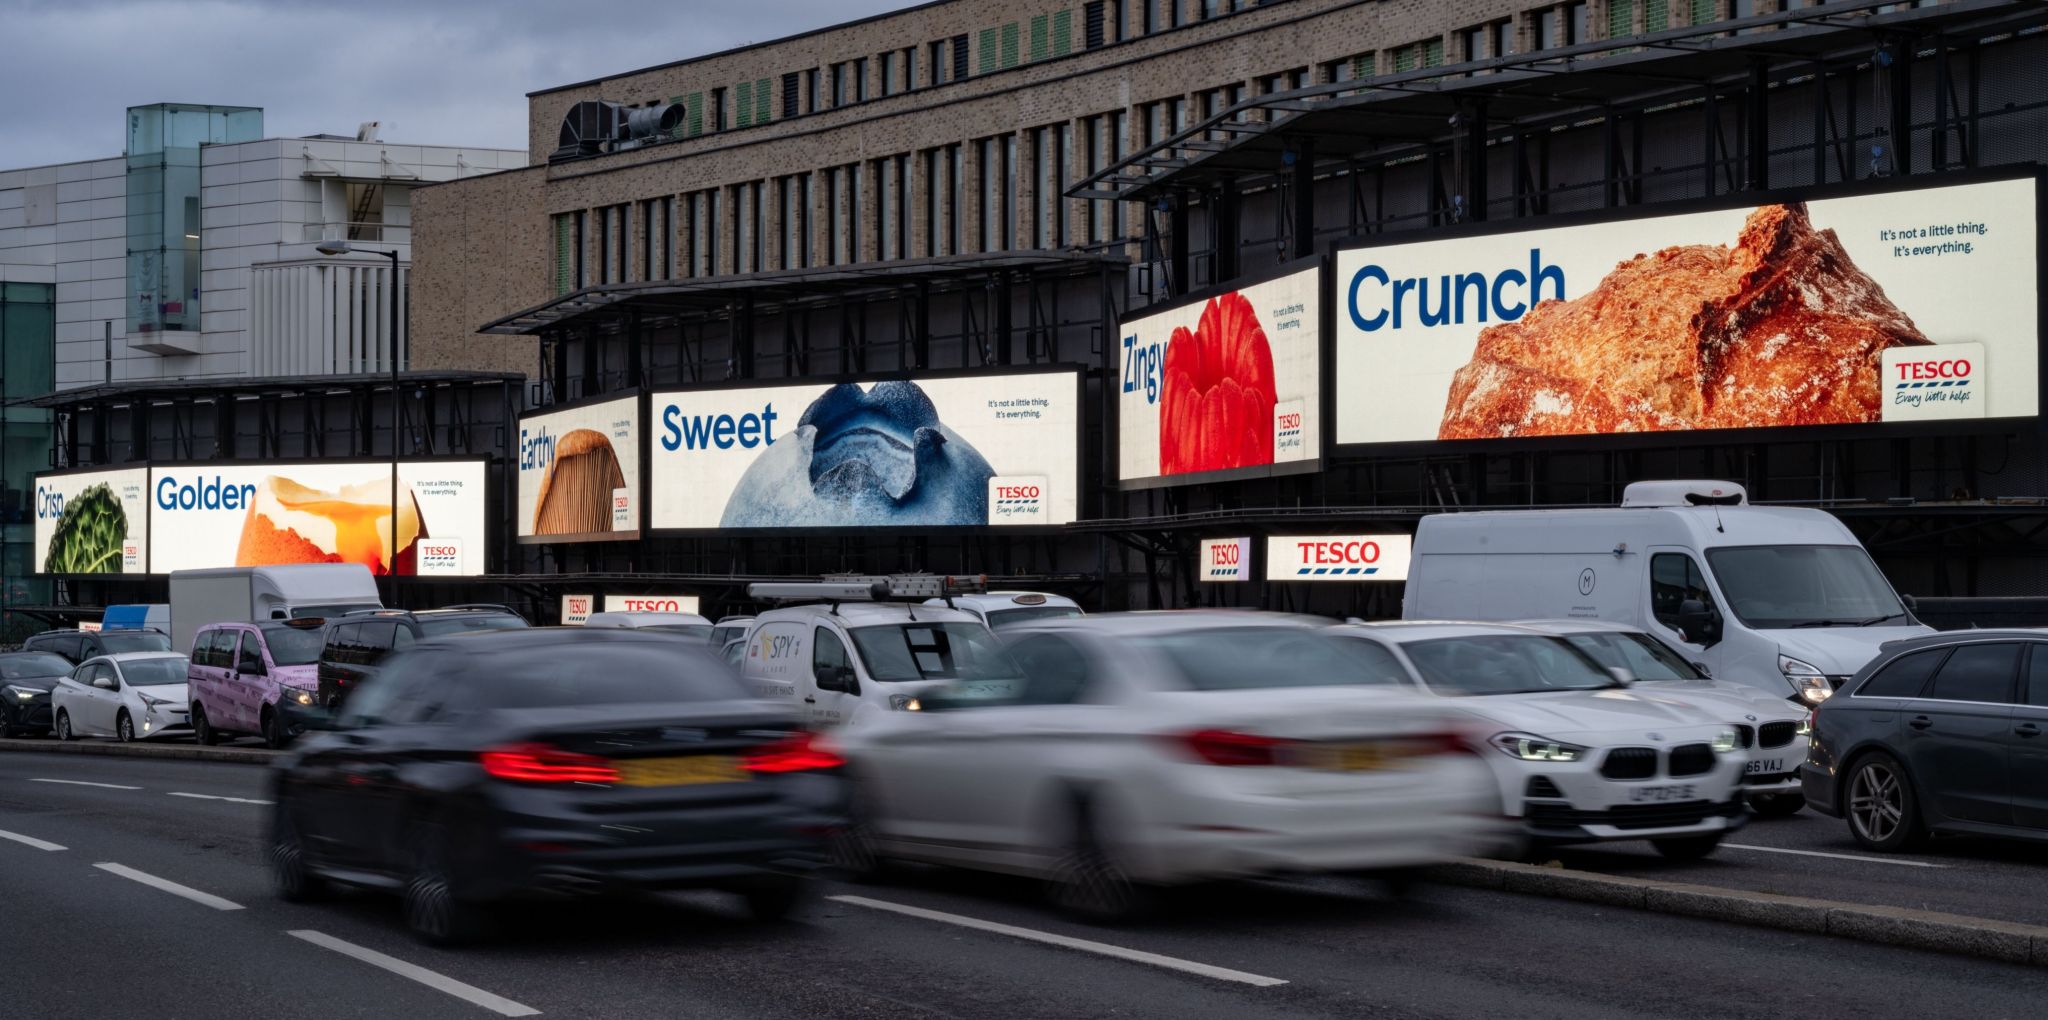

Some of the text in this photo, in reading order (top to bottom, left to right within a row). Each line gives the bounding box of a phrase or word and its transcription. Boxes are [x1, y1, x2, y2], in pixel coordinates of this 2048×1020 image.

[1880, 222, 1988, 241] It's not a little thing.
[1894, 241, 1974, 257] It's everything.
[1348, 248, 1565, 332] Crunch
[1123, 333, 1167, 404] Zingy
[1896, 359, 1971, 380] TESCO
[988, 400, 998, 408] It's
[1031, 398, 1049, 407] thing.
[1894, 390, 1971, 408] Every little helps
[996, 410, 1041, 420] It's everything.
[1278, 413, 1301, 429] TESCO
[661, 402, 777, 451] Sweet
[521, 425, 556, 479] Earthy
[157, 476, 256, 510] Golden
[996, 486, 1040, 498] TESCO
[37, 484, 64, 519] Crisp
[996, 505, 1012, 516] Every
[423, 546, 456, 555] TESCO
[1211, 543, 1239, 565] TESCO
[1297, 541, 1380, 564] TESCO
[568, 599, 587, 614] TESCO
[624, 600, 679, 613] TESCO
[771, 635, 795, 659] SPY
[1763, 759, 1783, 771] VAJ
